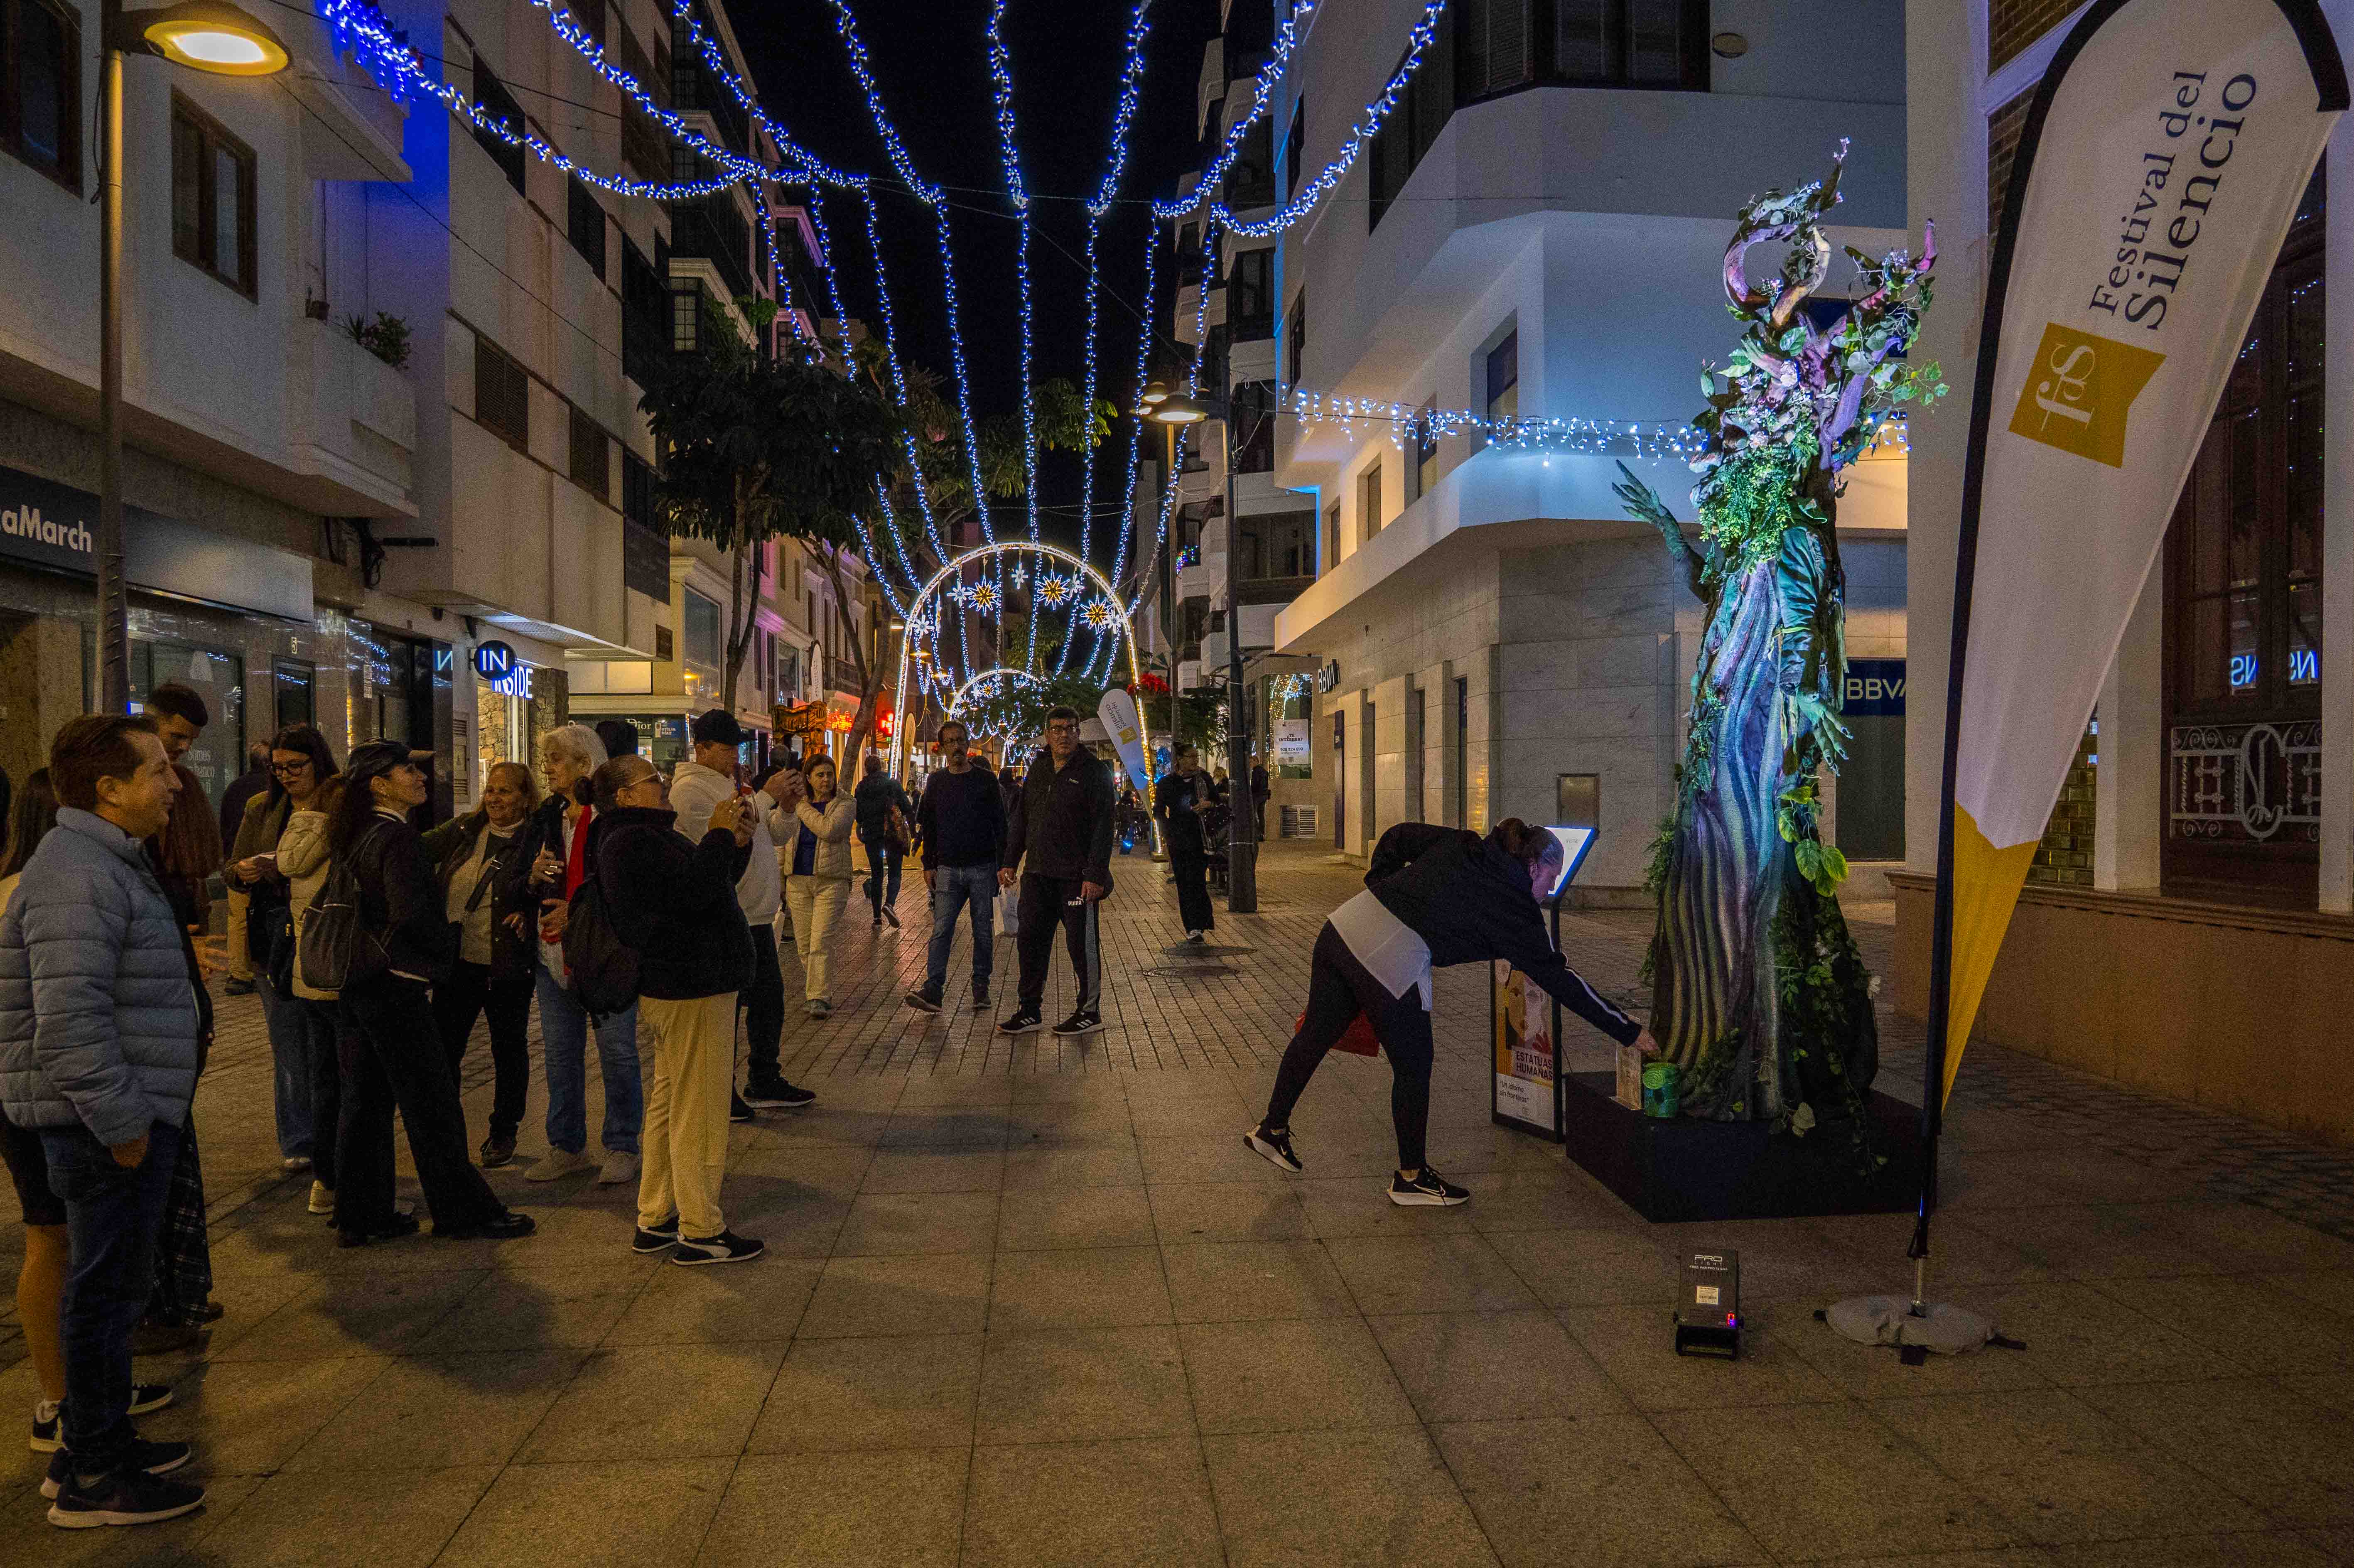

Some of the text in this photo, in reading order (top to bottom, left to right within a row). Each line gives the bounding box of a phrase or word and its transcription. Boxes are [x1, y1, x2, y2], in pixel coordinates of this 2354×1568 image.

[2089, 71, 2207, 316] Festival del
[2125, 73, 2257, 331] Silencio
[0, 504, 92, 552] aMarch
[482, 650, 507, 671] IN
[1318, 662, 1337, 694] BBVA
[1516, 1050, 1553, 1070] ESTATUAS
[1516, 1062, 1553, 1080] HUMANAS
